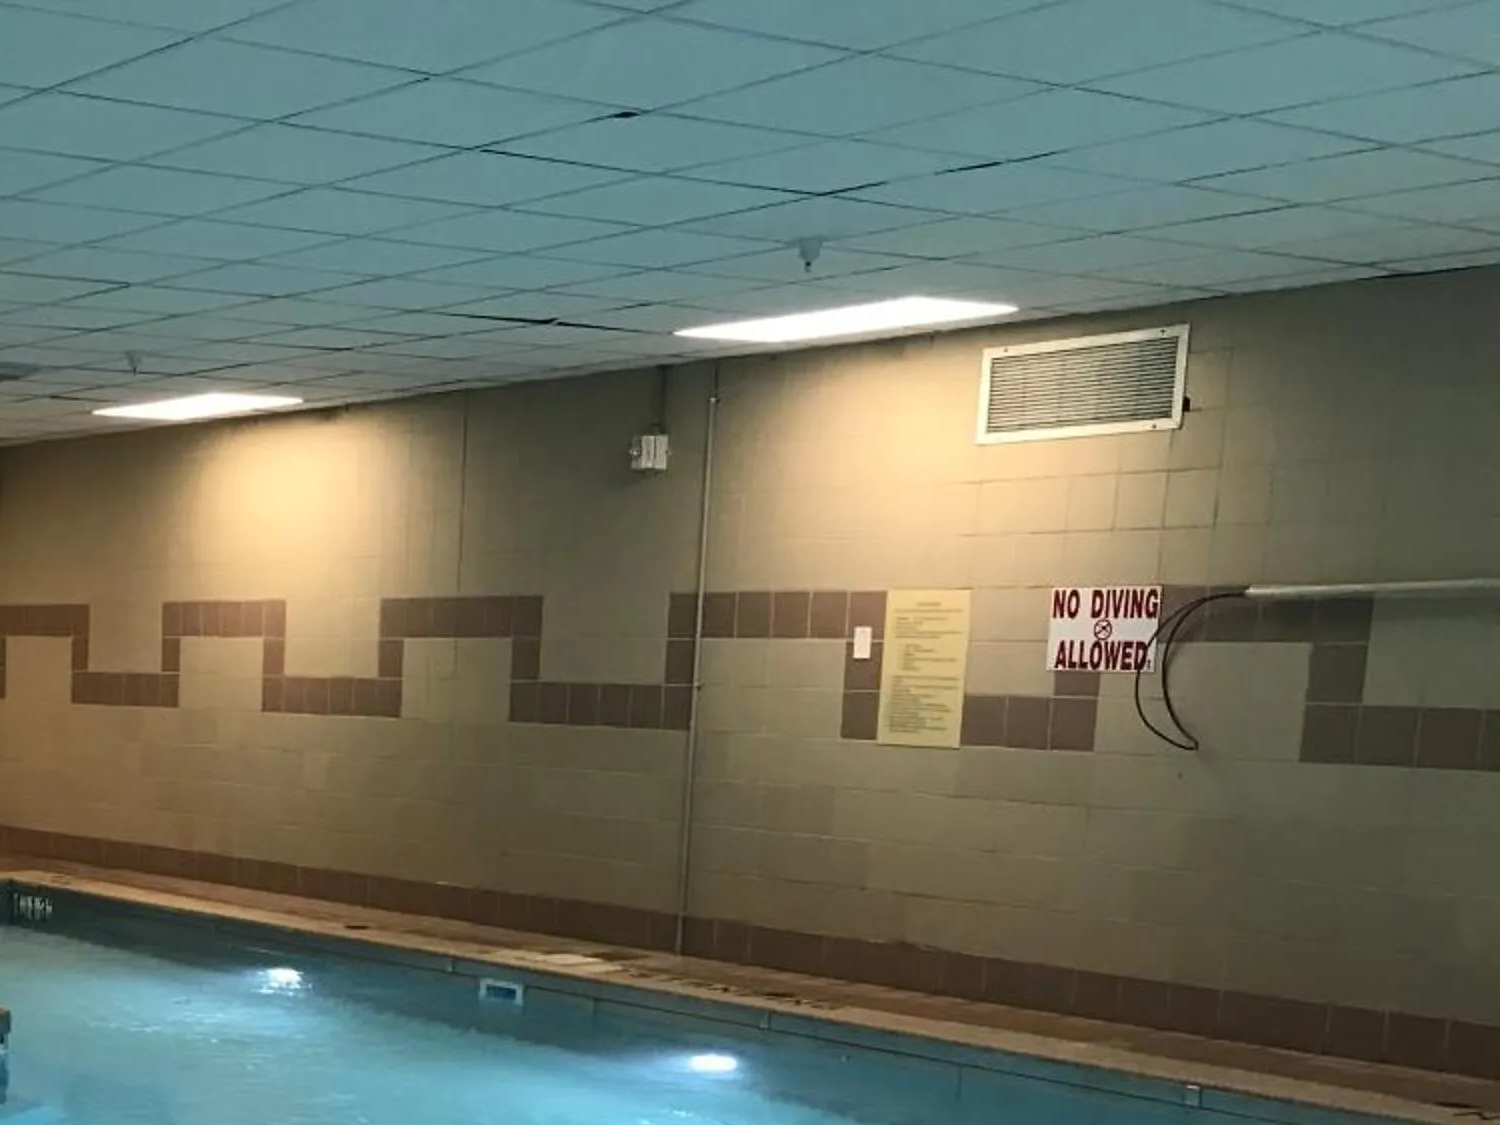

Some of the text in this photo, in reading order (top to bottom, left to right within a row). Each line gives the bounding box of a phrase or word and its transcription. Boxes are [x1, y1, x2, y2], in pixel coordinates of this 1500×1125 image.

[1052, 588, 1159, 619] NO DIVING
[1054, 640, 1149, 671] ALLOWED
